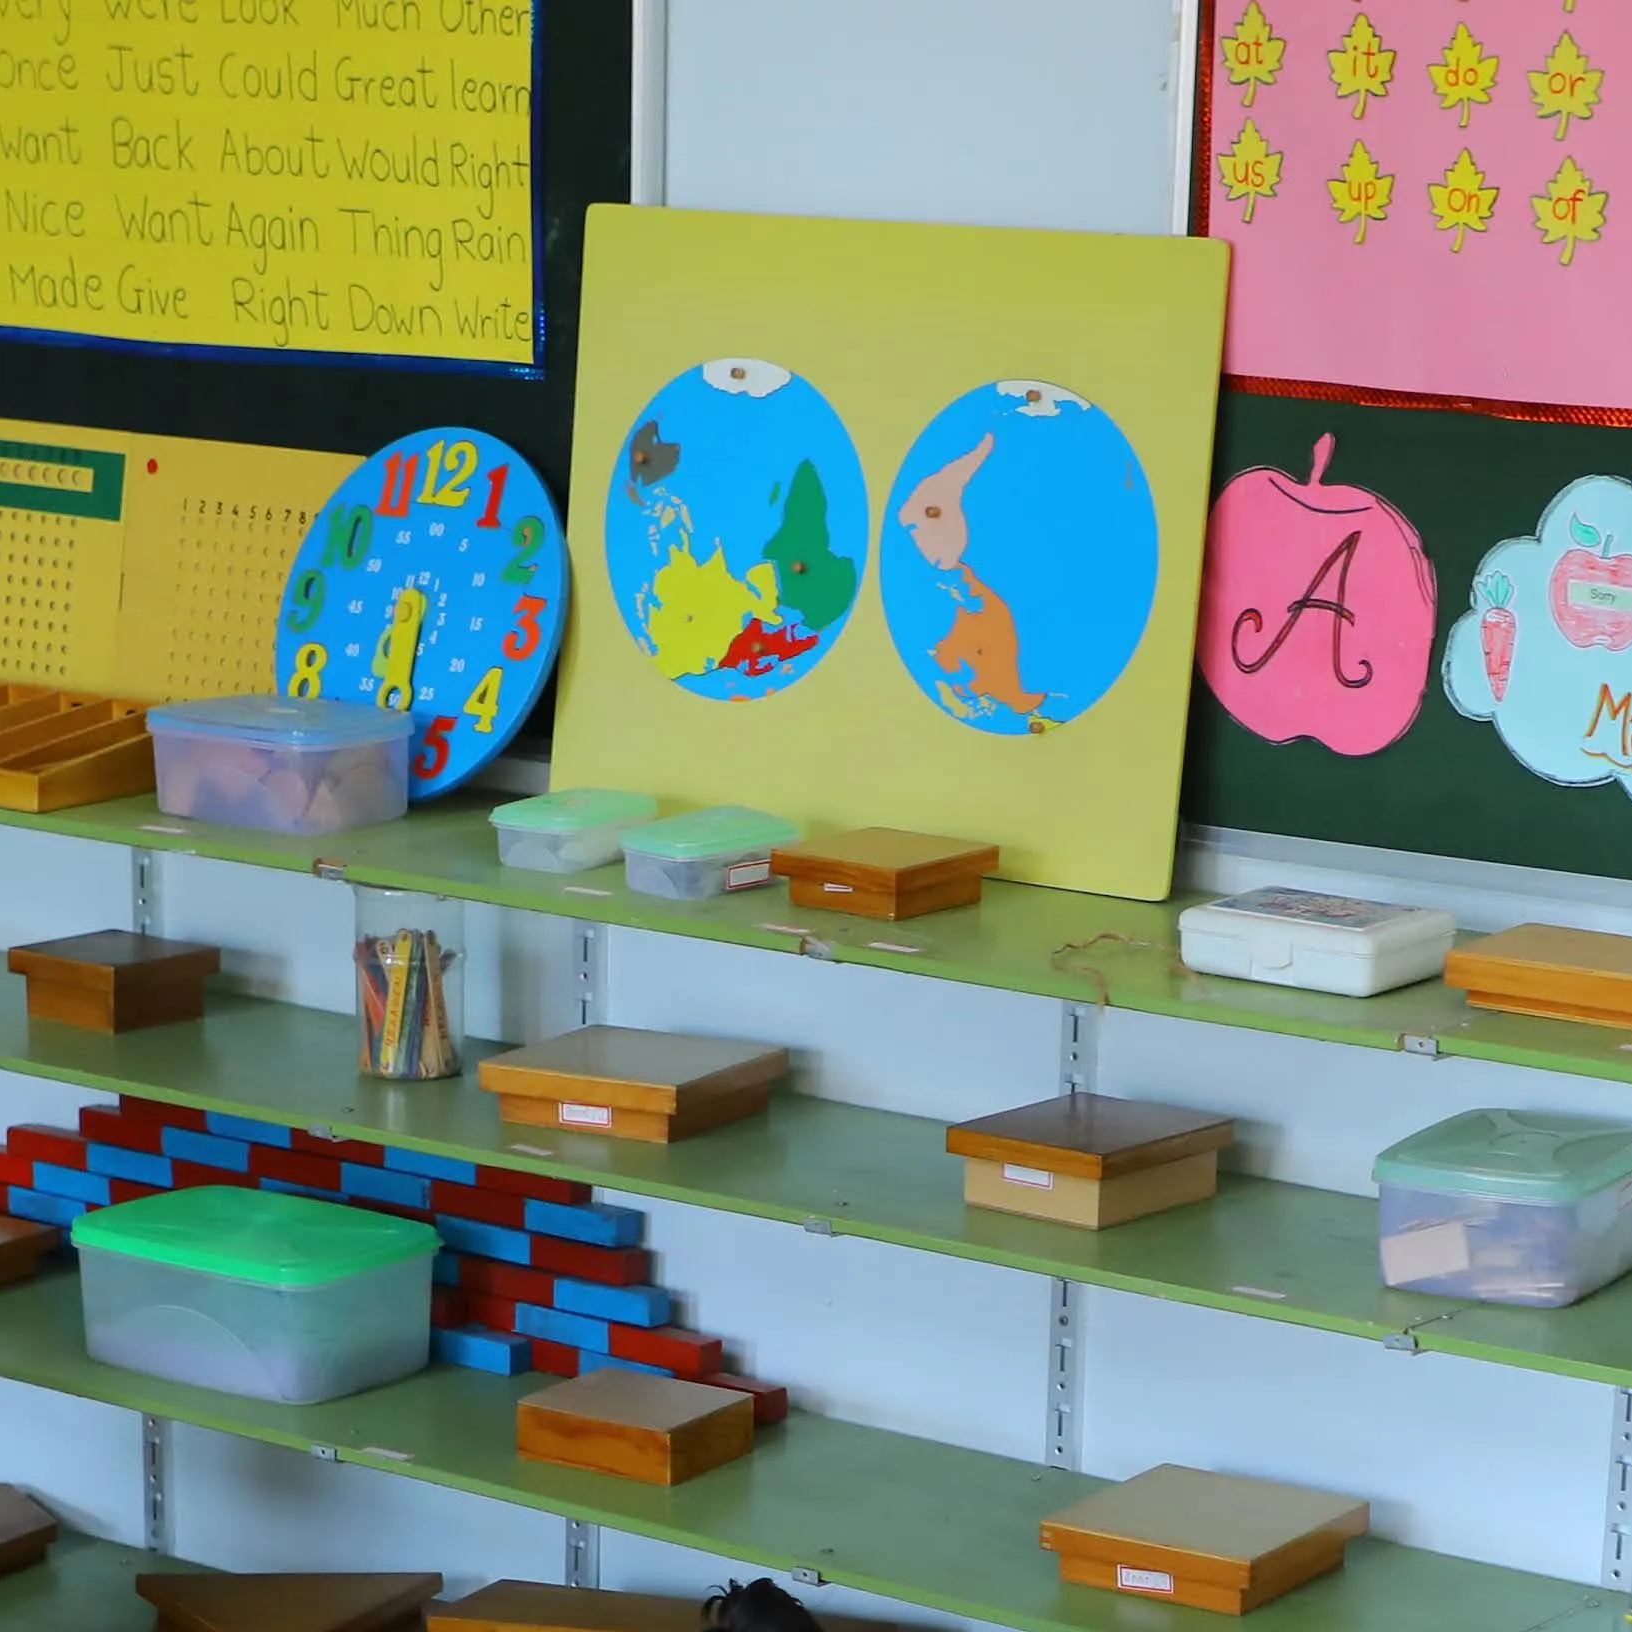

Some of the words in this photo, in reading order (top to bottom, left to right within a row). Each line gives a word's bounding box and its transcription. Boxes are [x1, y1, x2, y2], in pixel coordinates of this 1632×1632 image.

[337, 0, 420, 31] Much
[439, 0, 532, 36] Other
[1234, 36, 1263, 65] at
[1352, 42, 1379, 78] it
[1444, 57, 1479, 87] do
[106, 45, 199, 97] Just
[219, 50, 318, 102] Could
[334, 56, 438, 108] Great
[450, 57, 532, 117] learn
[1548, 72, 1585, 97] or
[111, 115, 196, 171] Back
[221, 127, 329, 178] About
[337, 134, 440, 188] Would
[449, 142, 531, 219] Right
[1233, 160, 1265, 188] us
[1347, 180, 1377, 212] up
[1552, 189, 1586, 224] of
[5, 188, 86, 238] Nice
[114, 190, 213, 247] Want
[226, 201, 319, 275] Again
[337, 207, 444, 291] Thing
[451, 218, 526, 263] Rain
[9, 254, 103, 311] Made
[118, 264, 189, 319] Give
[231, 276, 329, 347] Right
[348, 284, 443, 336] Down
[455, 297, 532, 342] Write
[375, 451, 419, 518] 11
[416, 440, 478, 507] 12
[476, 464, 510, 528] 1
[199, 500, 206, 514] 2
[216, 502, 223, 516] 3
[232, 504, 239, 517] 4
[249, 505, 257, 519] 5
[265, 508, 273, 521] 6
[284, 509, 292, 522] 7
[299, 511, 306, 525] 8
[319, 503, 373, 569] 10
[458, 538, 469, 552] 5
[500, 515, 545, 584] 2
[286, 568, 326, 634] 9
[472, 572, 486, 588] 10
[1589, 588, 1616, 605] Sorry
[469, 616, 483, 632] 15
[502, 594, 547, 662] 3
[1231, 530, 1373, 688] A
[429, 630, 438, 645] 4
[287, 643, 328, 698] 8
[418, 686, 435, 700] 25
[463, 666, 503, 733] 4
[414, 716, 458, 779] 5
